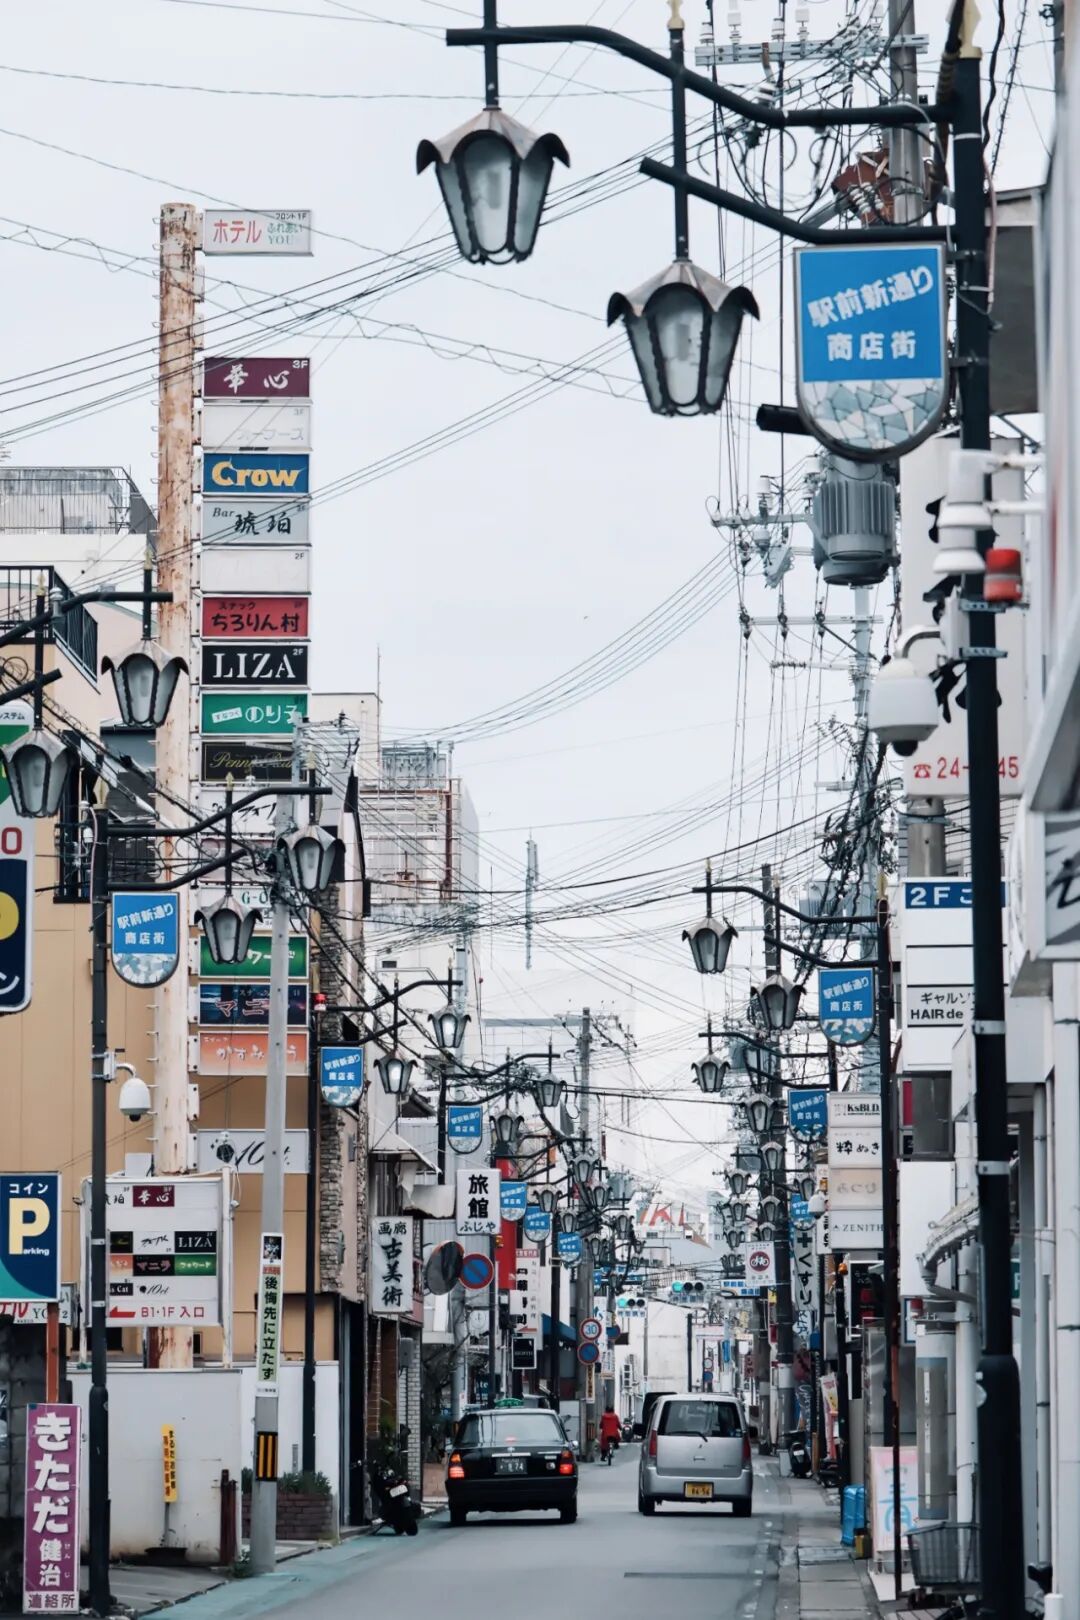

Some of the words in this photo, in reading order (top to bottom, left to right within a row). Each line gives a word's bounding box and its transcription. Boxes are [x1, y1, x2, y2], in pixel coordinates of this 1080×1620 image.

[213, 218, 262, 243] ホテル
[268, 235, 294, 245] YOU
[808, 265, 933, 328] 駅前新通り
[827, 330, 916, 361] 商店街
[292, 359, 309, 369] 3F
[211, 461, 300, 487] Crow
[212, 507, 236, 518] Bar
[211, 613, 299, 632] ちろりん村
[292, 648, 304, 656] 2F
[213, 653, 296, 679] LIZA
[937, 756, 1019, 778] 24-45
[116, 902, 174, 930] 駅前新通り
[125, 931, 165, 945] 商店街
[215, 998, 270, 1016] マニ
[830, 1000, 863, 1012] 商店街
[910, 1009, 944, 1020] HAIR
[945, 1009, 964, 1020] de
[9, 1182, 49, 1195] コイン
[467, 1174, 488, 1219] 旅館
[377, 1221, 407, 1235] 画廊
[459, 1220, 496, 1233] ふじや
[842, 1224, 884, 1232] ZENITH
[178, 1236, 213, 1248] LIZA
[381, 1238, 404, 1307] 古美術
[797, 1252, 813, 1305] くすり
[179, 1306, 205, 1318] 入口
[262, 1276, 279, 1381] 後悔先に立たず
[585, 1324, 598, 1335] 30
[28, 1594, 75, 1608] 連絡所
